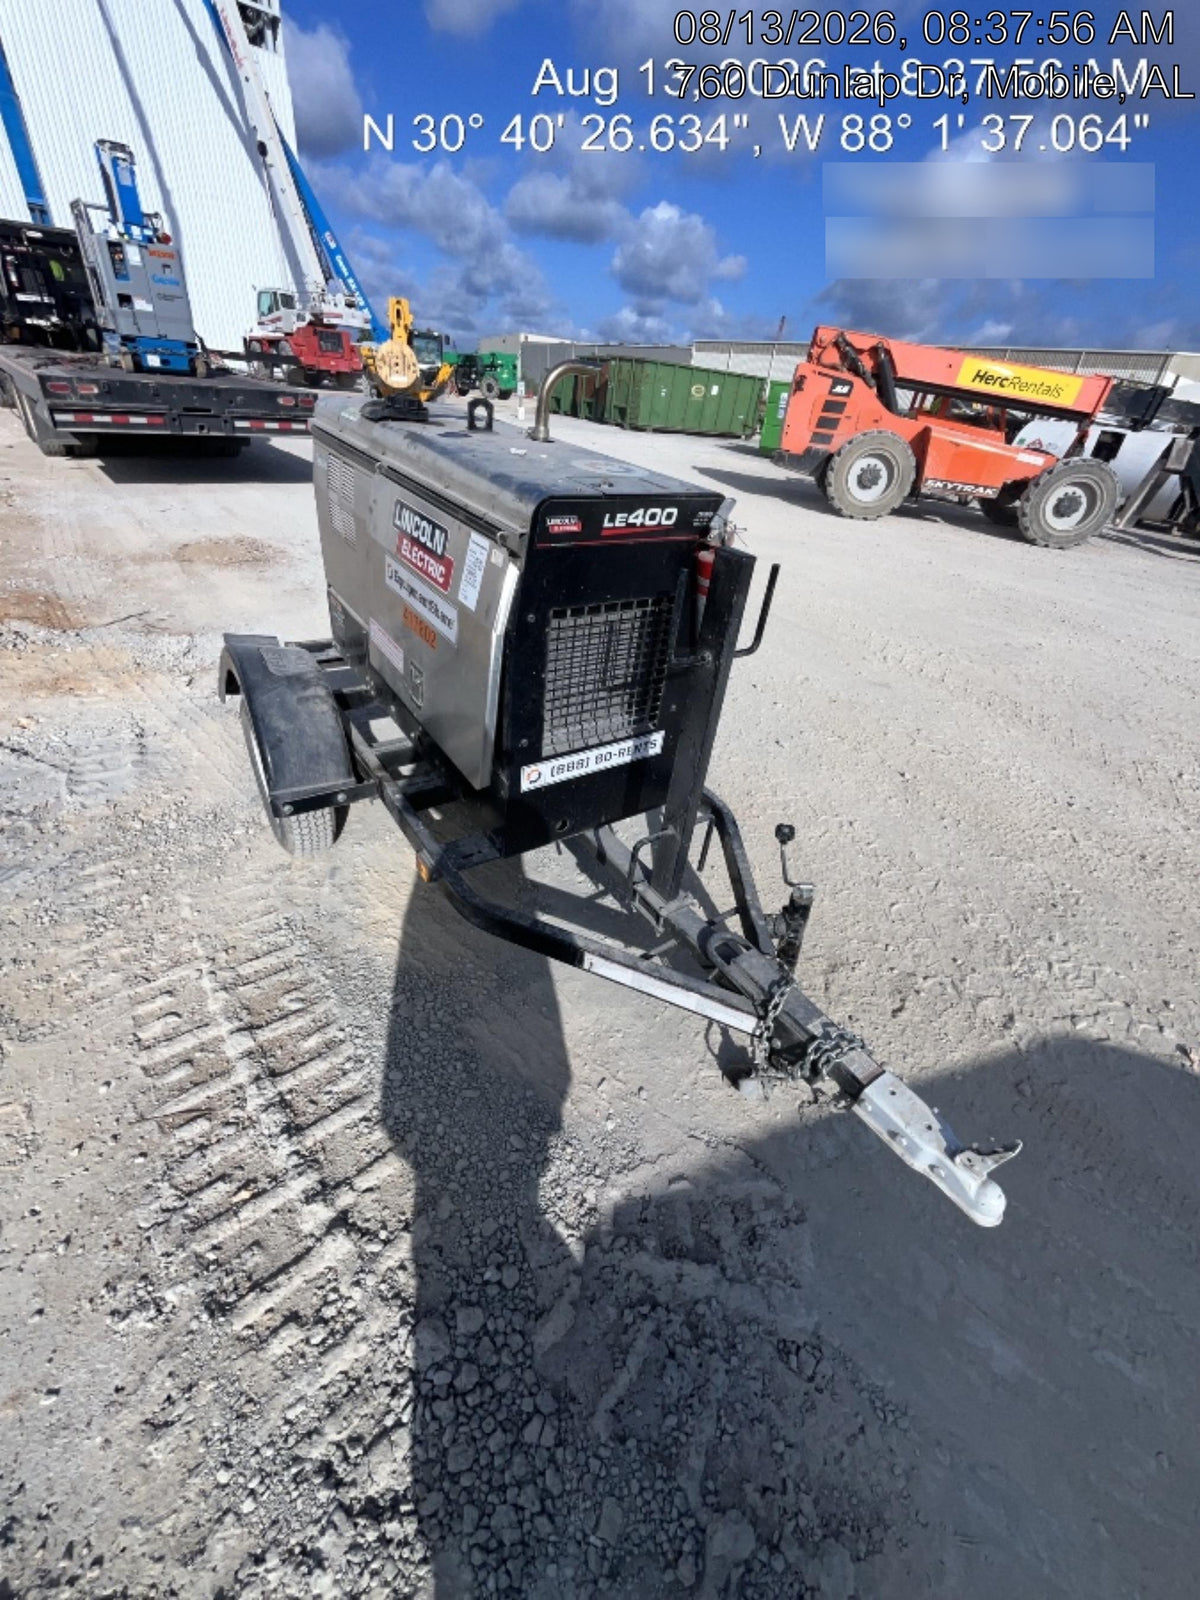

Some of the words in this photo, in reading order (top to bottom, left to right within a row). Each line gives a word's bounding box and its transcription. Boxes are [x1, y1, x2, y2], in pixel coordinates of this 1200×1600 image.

[972, 369, 1064, 399] HercRentals
[925, 479, 998, 495] SKYTRAK
[395, 504, 446, 555] LINCOLN
[602, 507, 679, 528] LE400
[401, 538, 446, 584] ELECTRIC
[550, 757, 590, 778] (888)
